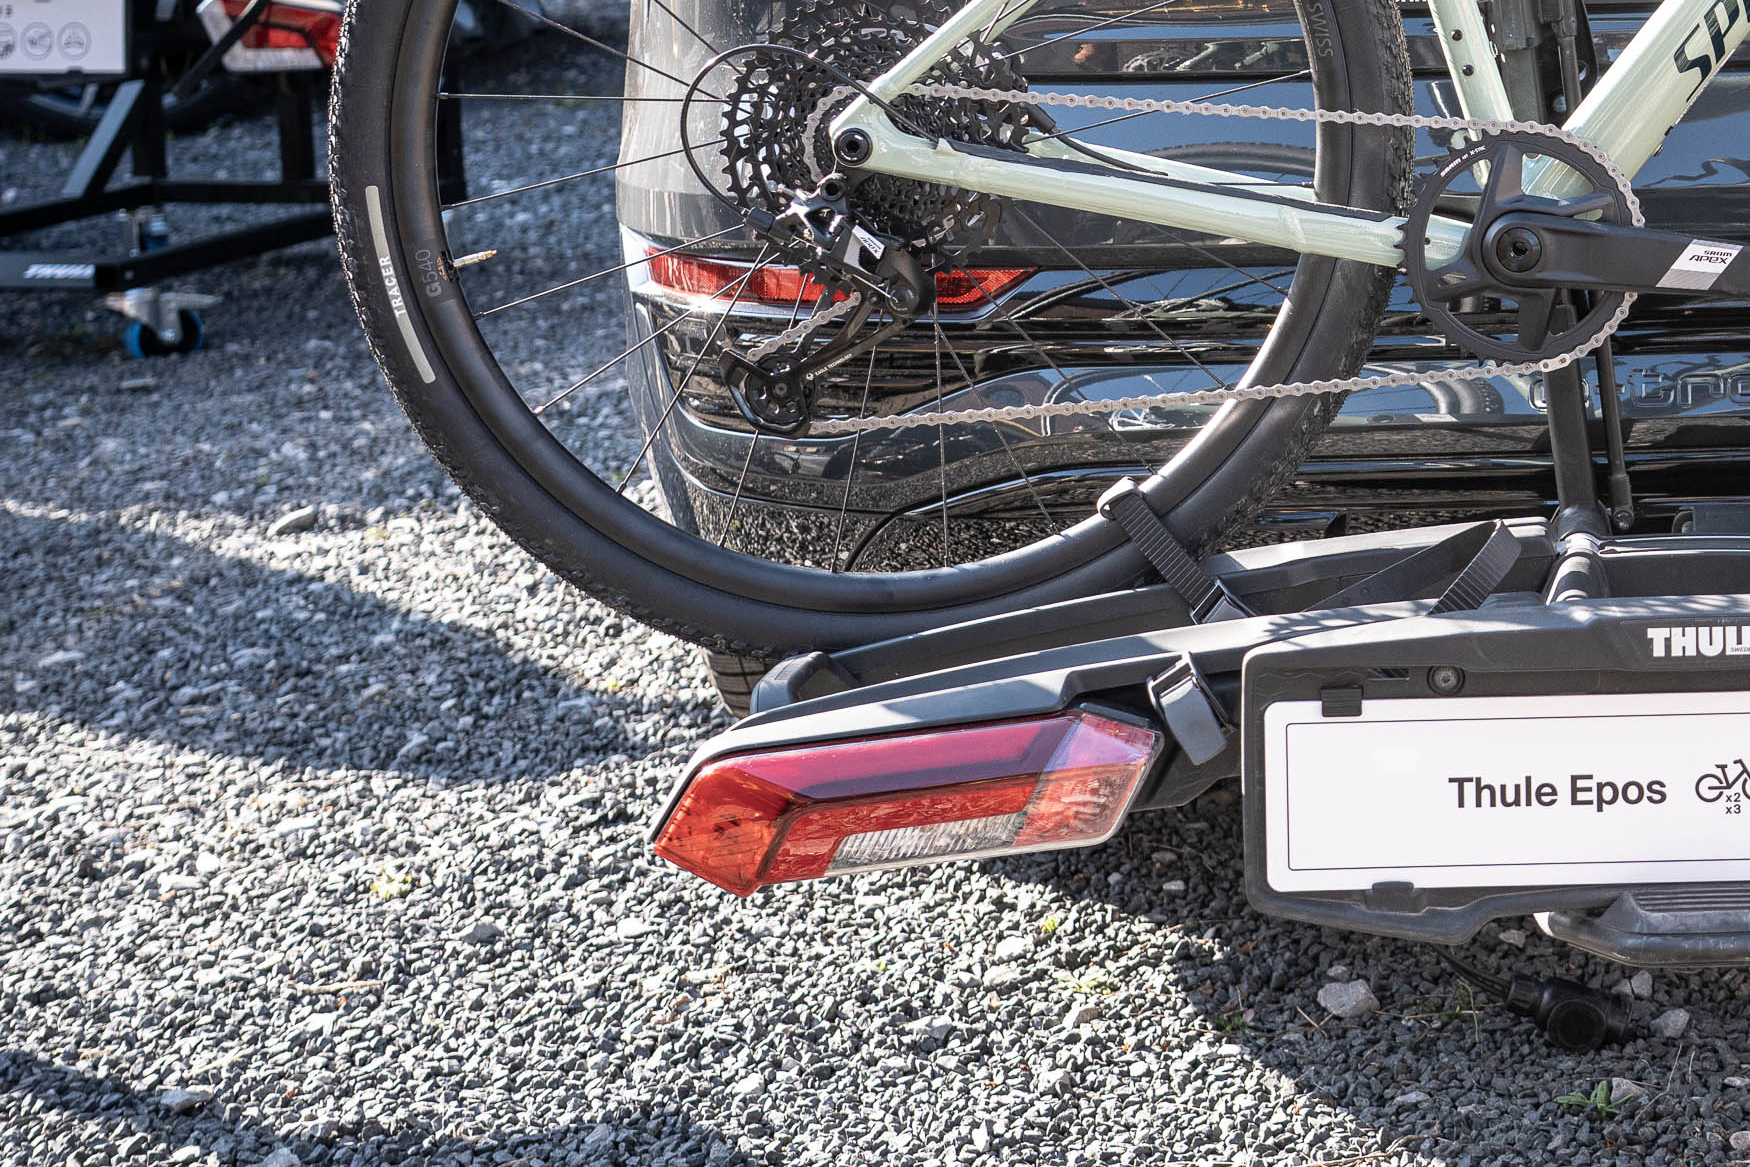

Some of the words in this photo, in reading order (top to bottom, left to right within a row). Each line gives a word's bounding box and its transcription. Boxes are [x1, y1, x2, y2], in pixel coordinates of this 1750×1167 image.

[1307, 2, 1334, 58] SWISS
[379, 255, 408, 318] TRACER
[415, 249, 442, 297] G540
[1448, 775, 1558, 809] Thule
[1570, 774, 1668, 813] Epos
[1725, 792, 1741, 803] x2
[1725, 804, 1741, 815] x3
